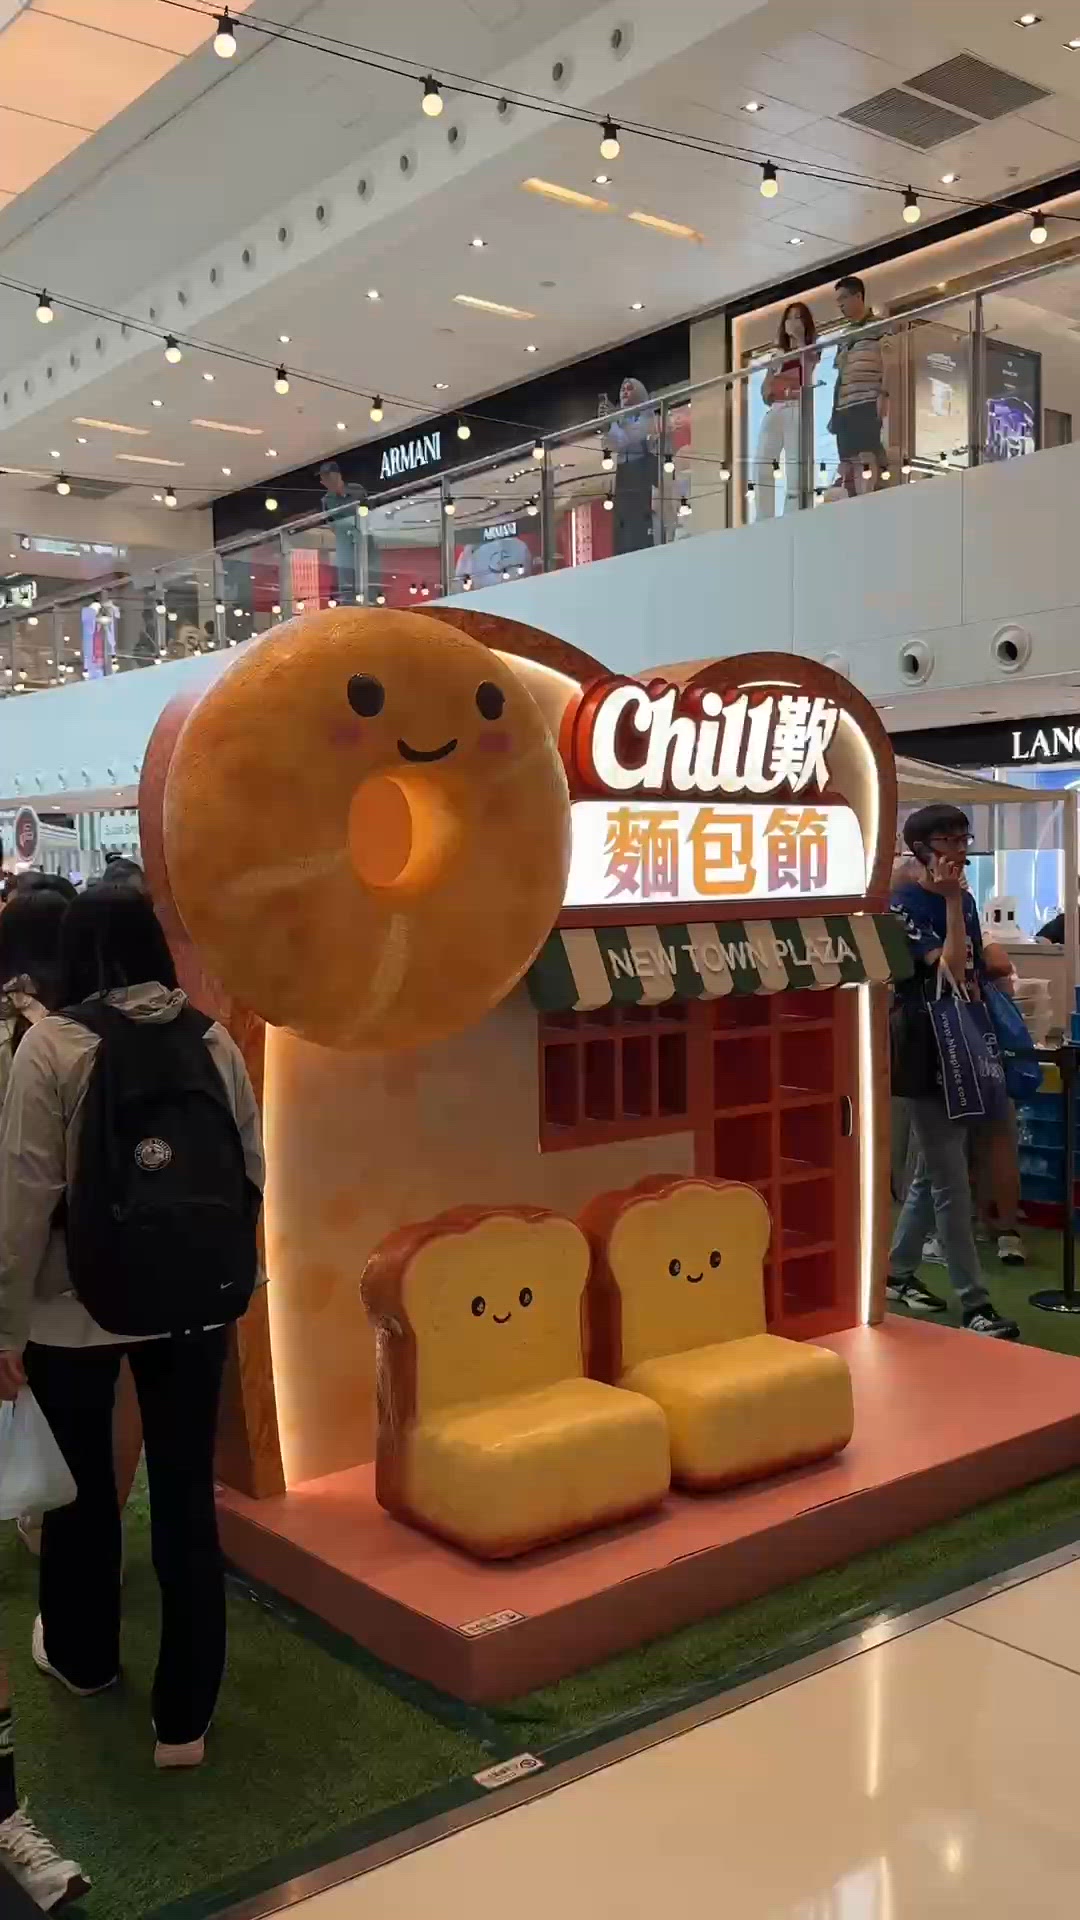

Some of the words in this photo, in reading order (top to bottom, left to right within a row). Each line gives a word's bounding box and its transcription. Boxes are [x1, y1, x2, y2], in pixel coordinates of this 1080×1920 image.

[380, 431, 441, 479] ARMANI
[1012, 726, 1080, 760] LAN
[604, 807, 829, 899] 麵包節
[607, 944, 678, 979] NEW
[681, 938, 769, 973] TOWN
[772, 935, 857, 968] PLAZA
